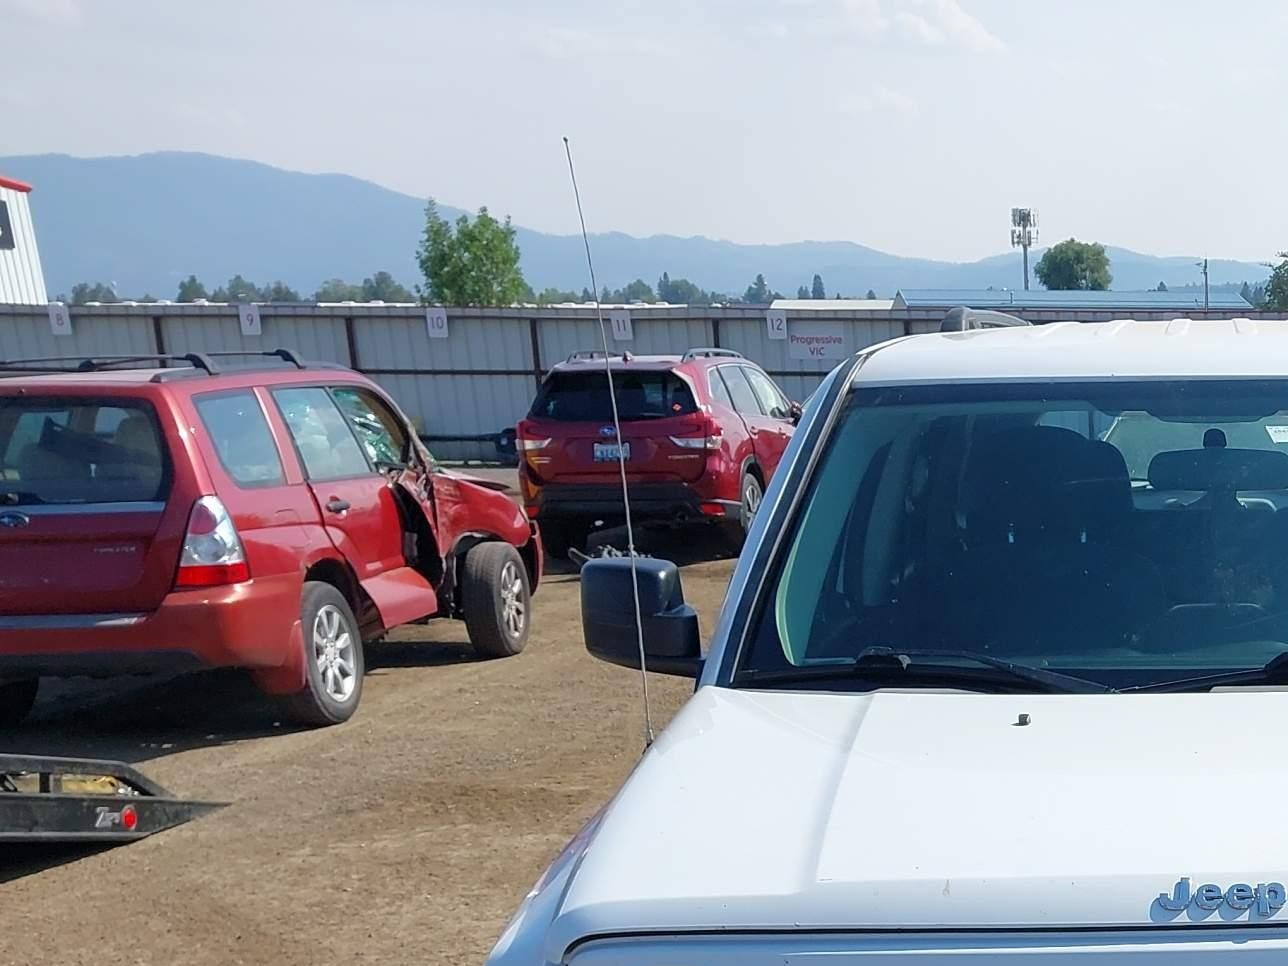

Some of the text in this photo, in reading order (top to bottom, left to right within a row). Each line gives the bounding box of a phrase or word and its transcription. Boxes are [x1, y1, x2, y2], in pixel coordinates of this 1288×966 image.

[55, 312, 65, 327] 8
[246, 312, 254, 327] 9
[430, 316, 444, 329] 10
[770, 318, 783, 331] 12
[790, 335, 842, 345] Progressive
[808, 347, 825, 356] VIC
[1157, 877, 1287, 917] Jeep
